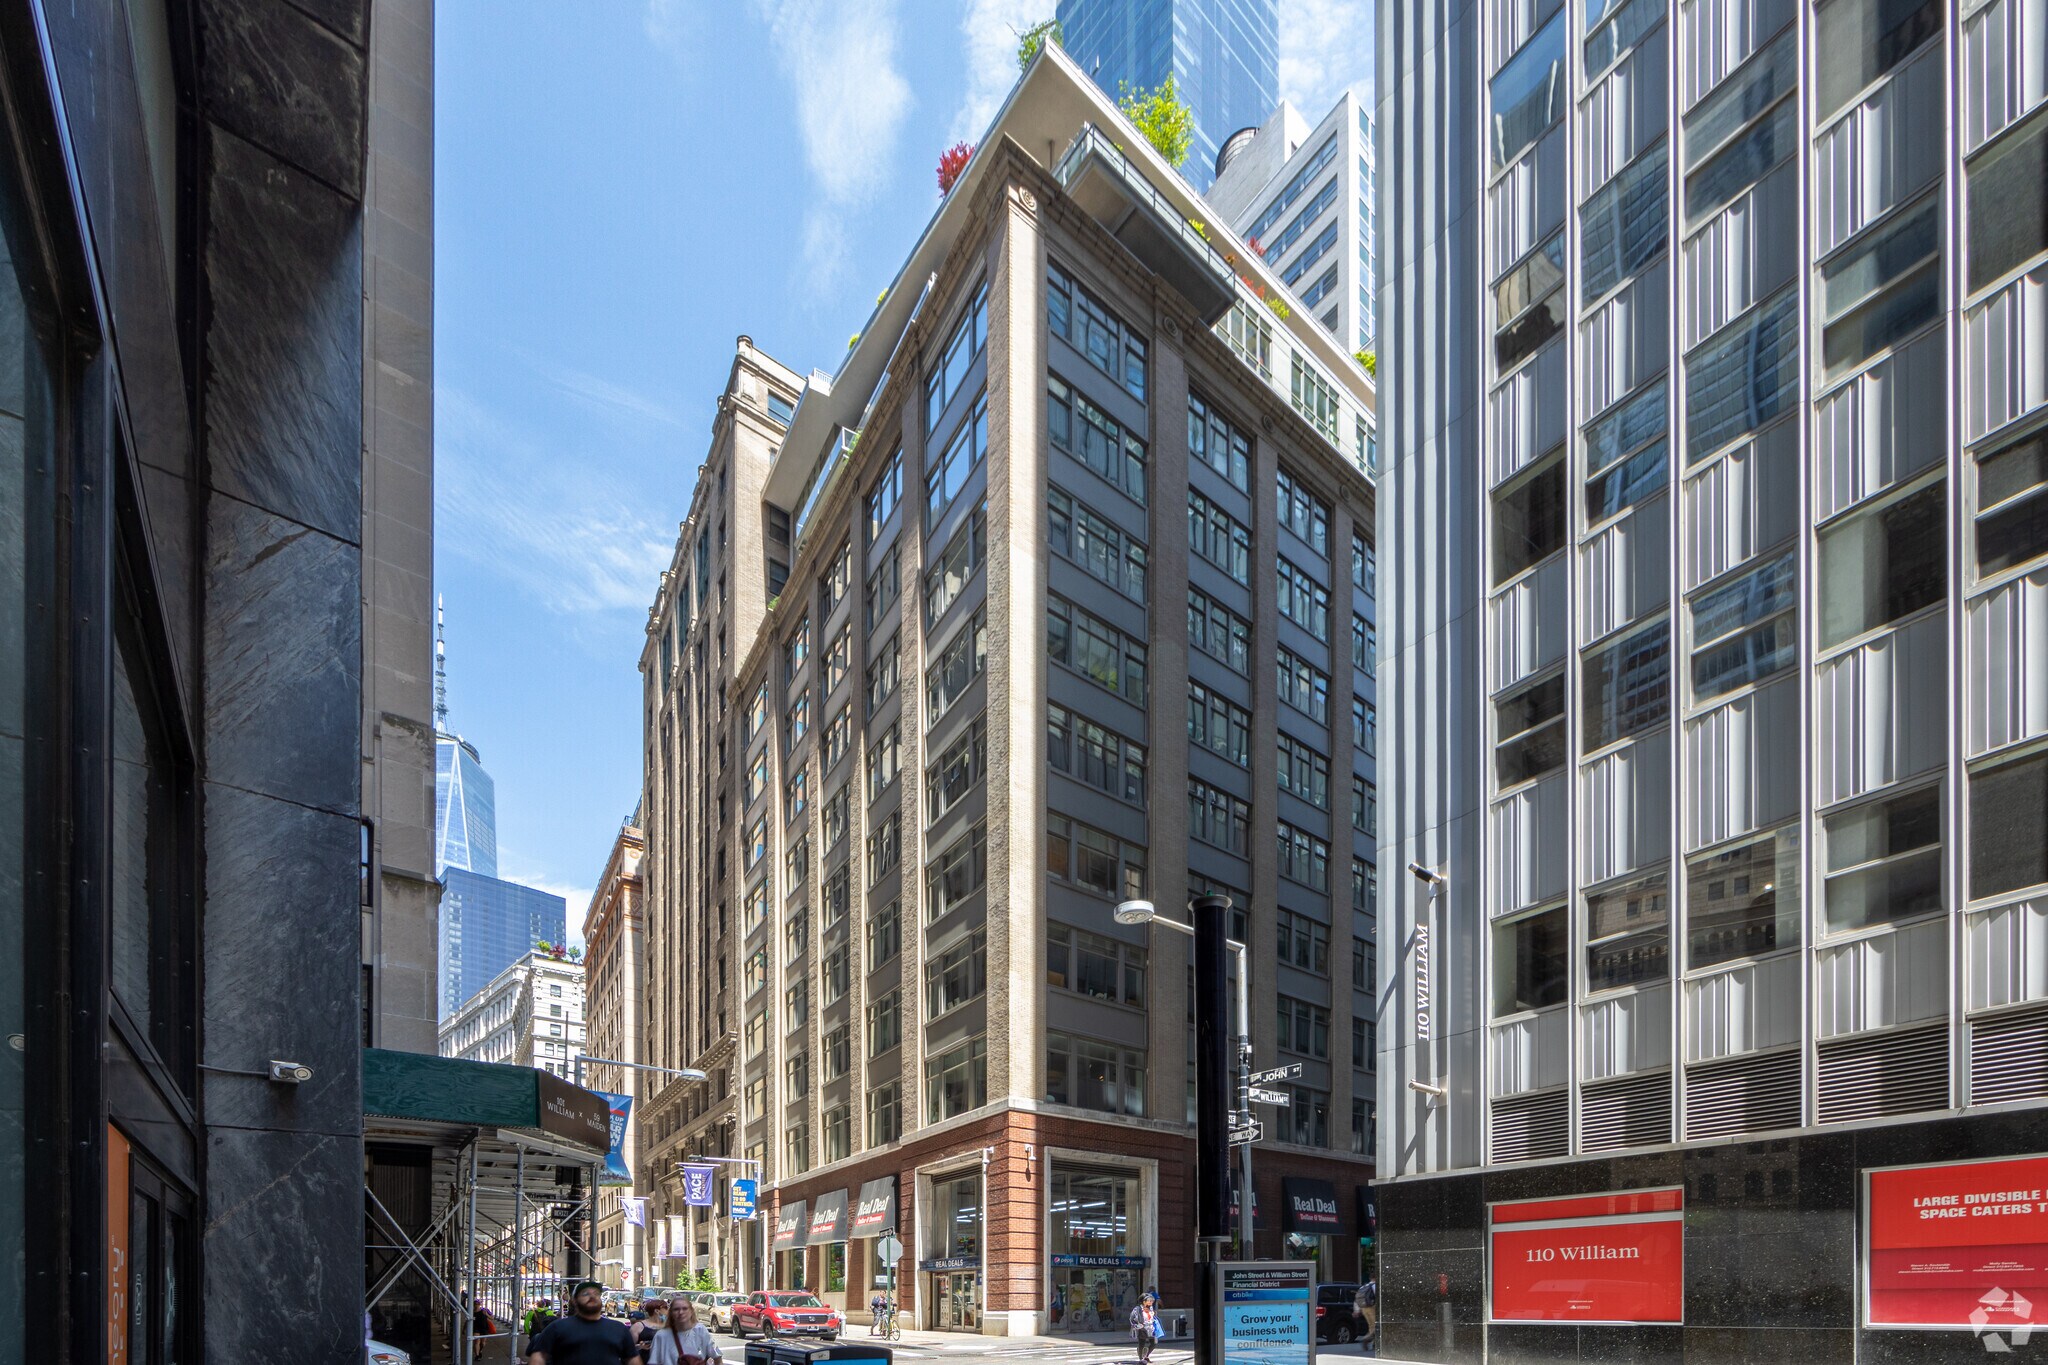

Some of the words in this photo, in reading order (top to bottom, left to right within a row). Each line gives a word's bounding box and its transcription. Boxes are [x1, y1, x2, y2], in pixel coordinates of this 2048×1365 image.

[1417, 923, 1429, 1010] WILLIAM
[1417, 1013, 1430, 1041] 110
[1263, 1068, 1287, 1082] JOHN
[1260, 1094, 1284, 1104] WILLIAM
[546, 1101, 574, 1119] WILLIAM
[586, 1118, 606, 1133] MAIDEN
[691, 1173, 702, 1200] PACE
[858, 1199, 874, 1216] Real
[872, 1195, 890, 1212] Deal
[1294, 1196, 1315, 1212] Real
[1316, 1198, 1336, 1214] Deal
[1914, 1196, 1959, 1207] LARGE
[1964, 1190, 2041, 1204] DIVISIBLE
[812, 1210, 826, 1225] Real
[824, 1207, 840, 1222] Deal
[1920, 1208, 1966, 1219] SPACE
[1972, 1203, 2032, 1216] CATERS
[2038, 1202, 2048, 1212] T
[777, 1220, 788, 1233] Real
[786, 1217, 798, 1231] Deal
[1526, 1248, 1555, 1262] 110
[1560, 1245, 1640, 1260] William
[936, 1260, 947, 1268] REAL
[1241, 1315, 1268, 1324] Grow
[1270, 1314, 1292, 1324] your
[1232, 1327, 1276, 1336] business
[1278, 1325, 1299, 1334] with
[1237, 1338, 1294, 1348] confidence.
